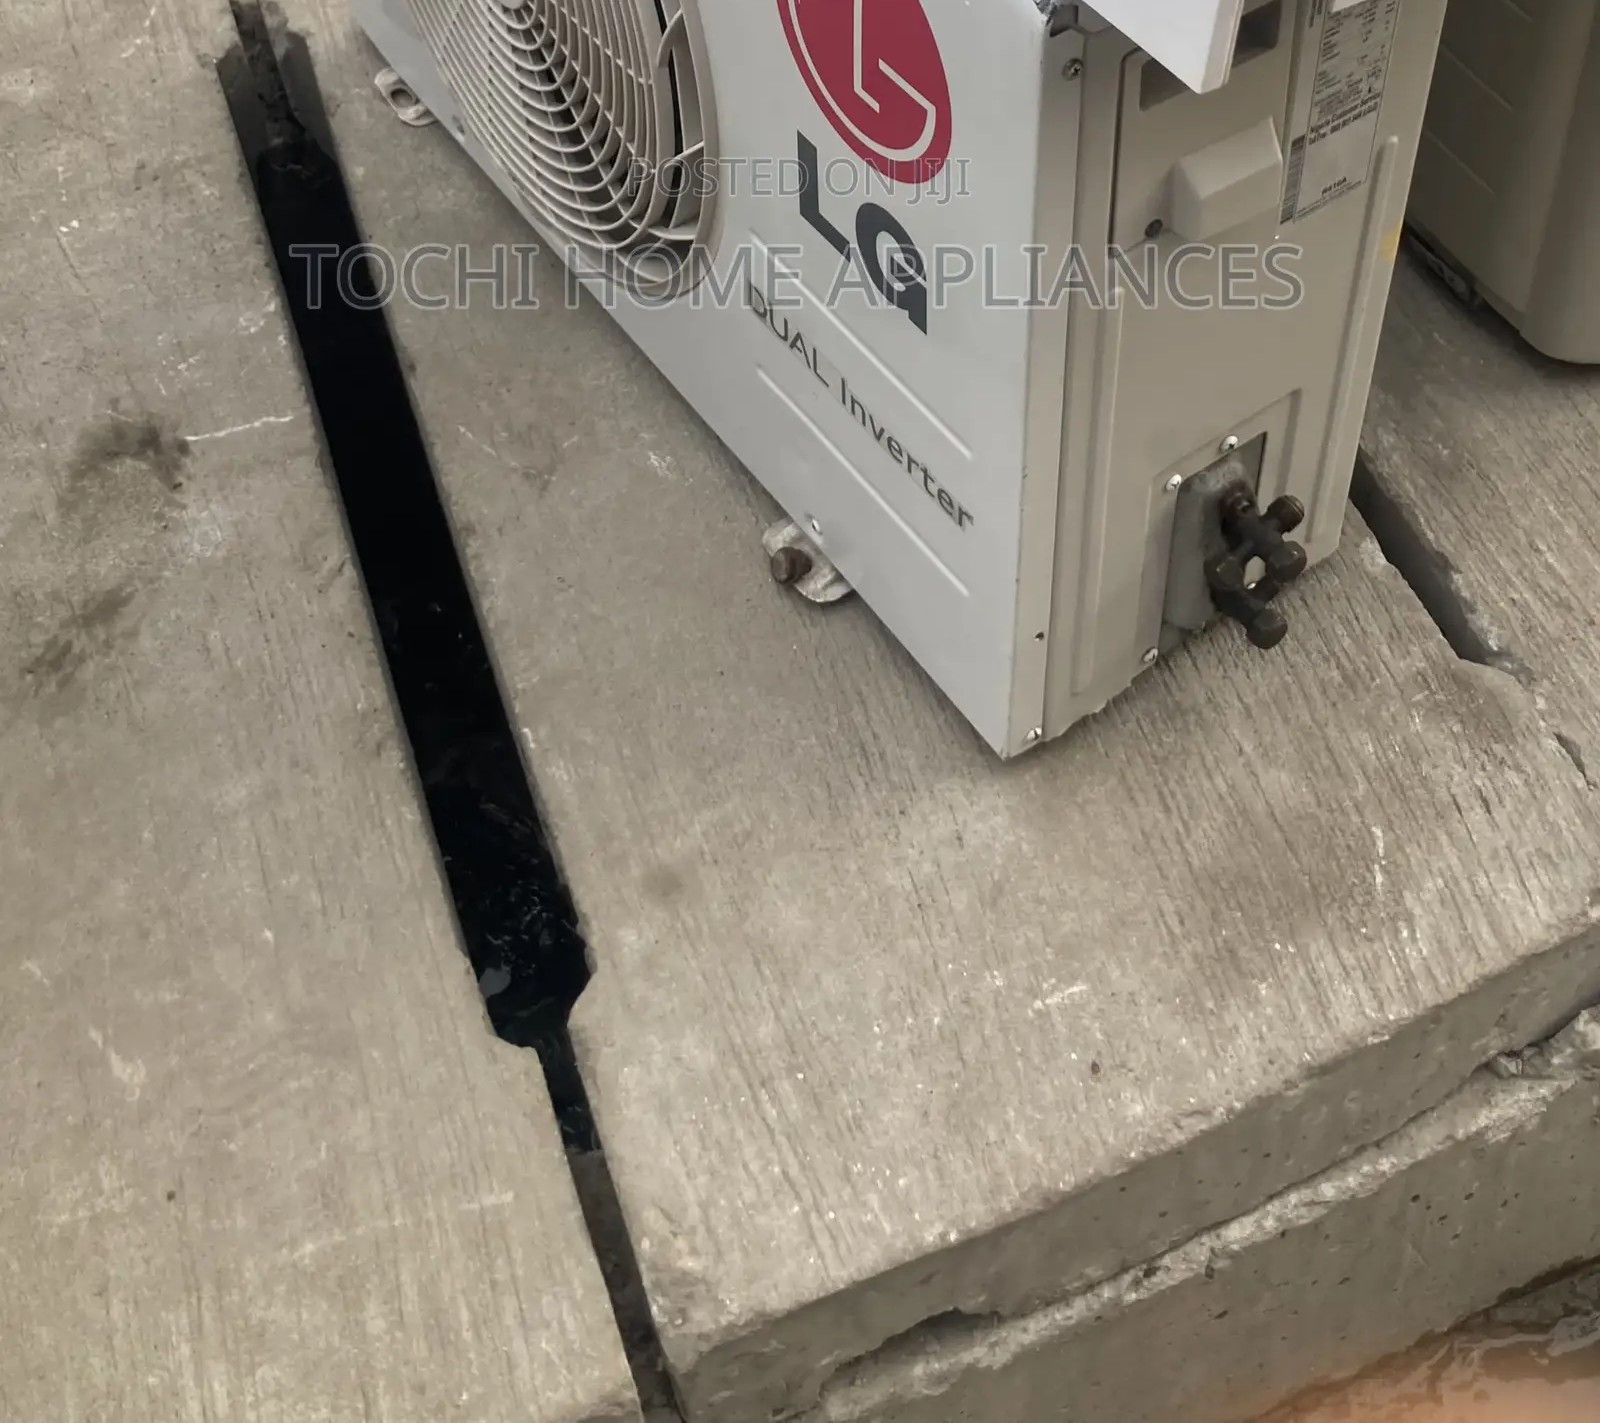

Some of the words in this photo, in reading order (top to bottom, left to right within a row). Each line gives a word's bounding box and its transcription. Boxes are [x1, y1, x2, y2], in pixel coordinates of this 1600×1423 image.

[797, 129, 928, 336] LG
[749, 278, 830, 388] DUAL
[840, 377, 975, 531] Inverter
